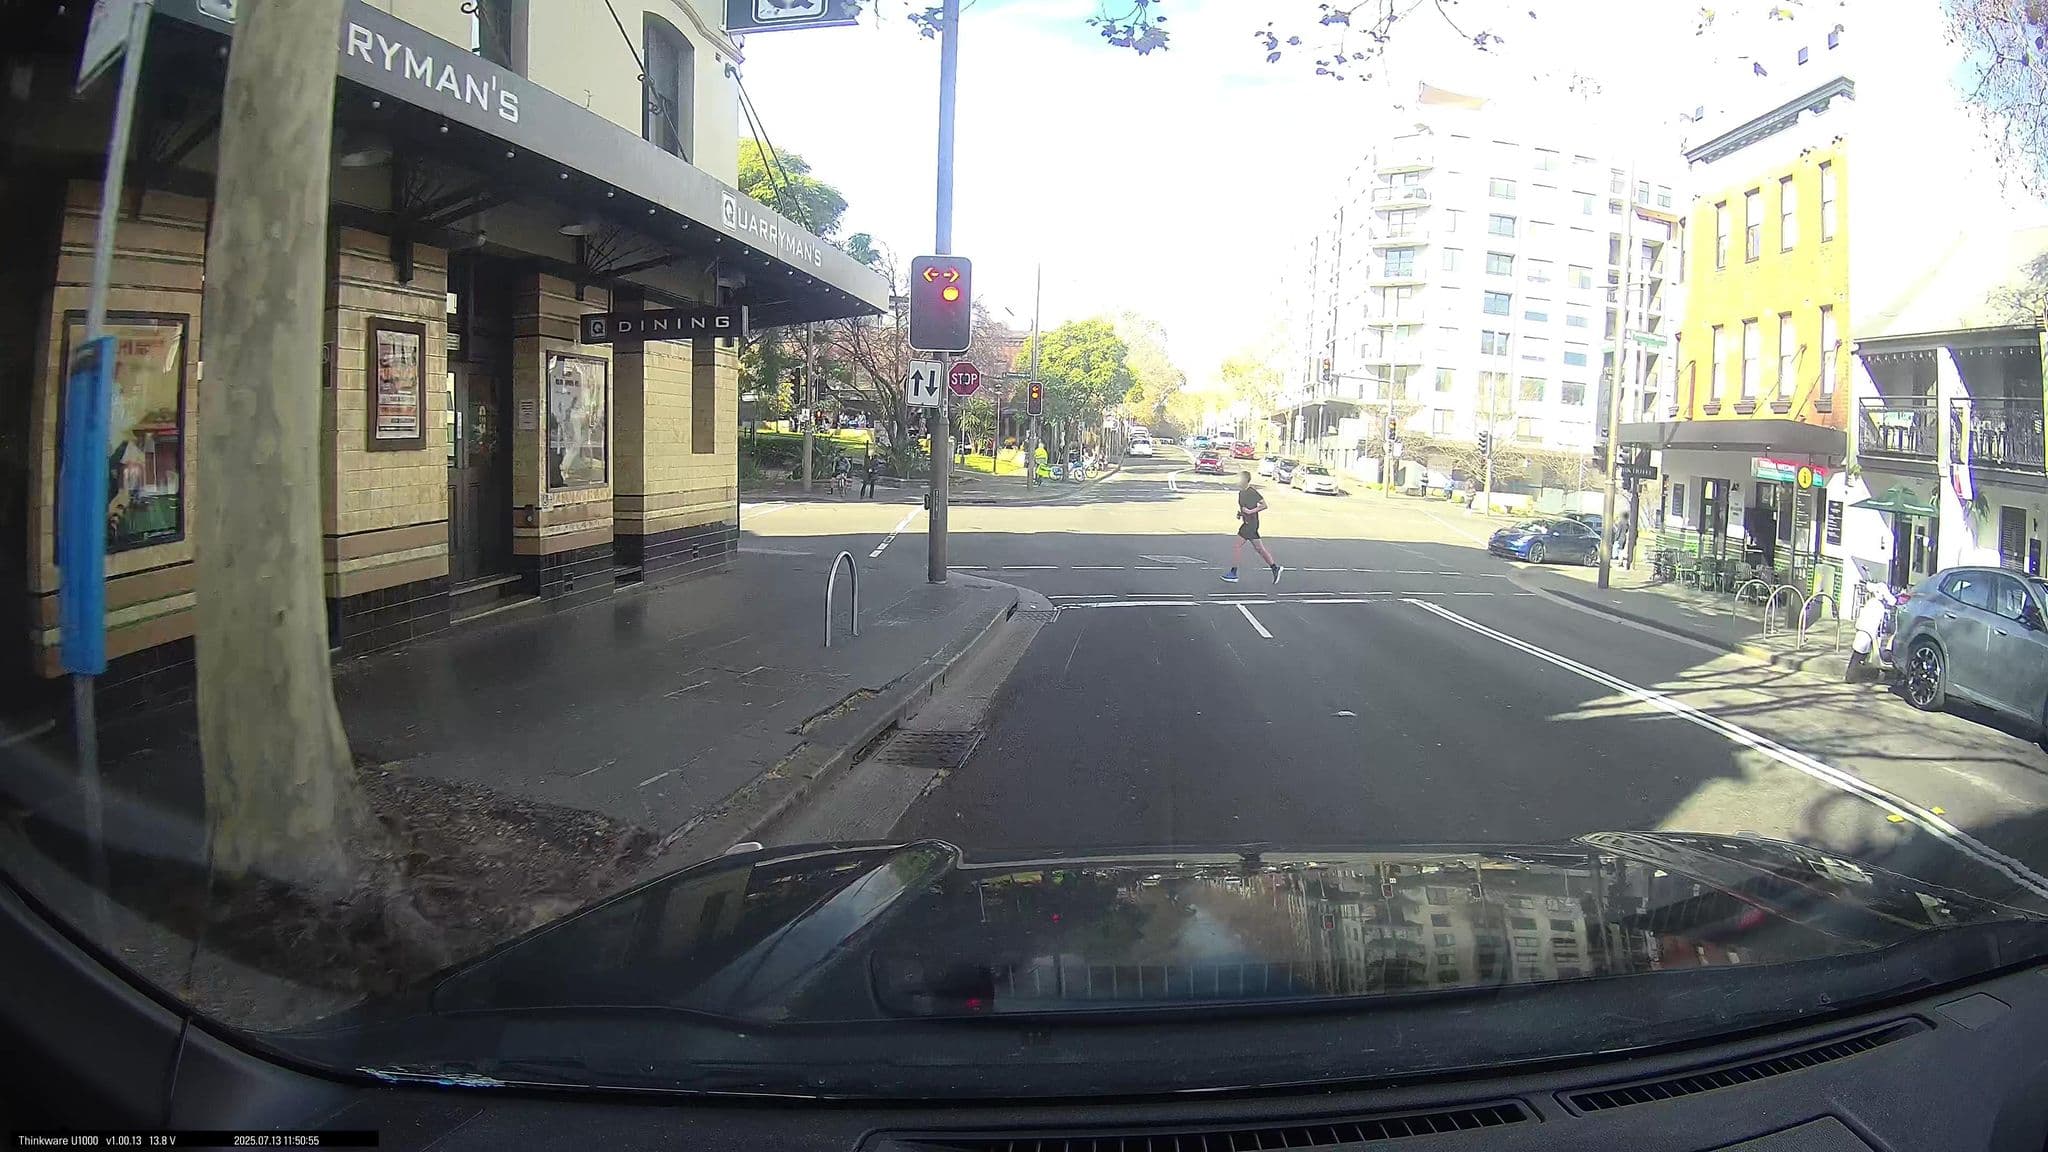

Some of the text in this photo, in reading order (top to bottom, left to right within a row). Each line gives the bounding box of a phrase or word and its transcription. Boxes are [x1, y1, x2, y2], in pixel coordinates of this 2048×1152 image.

[346, 22, 519, 124] RYMAN'S
[722, 190, 822, 268] QUARRYMAN'S
[618, 316, 730, 333] DINING
[951, 372, 978, 386] STOP
